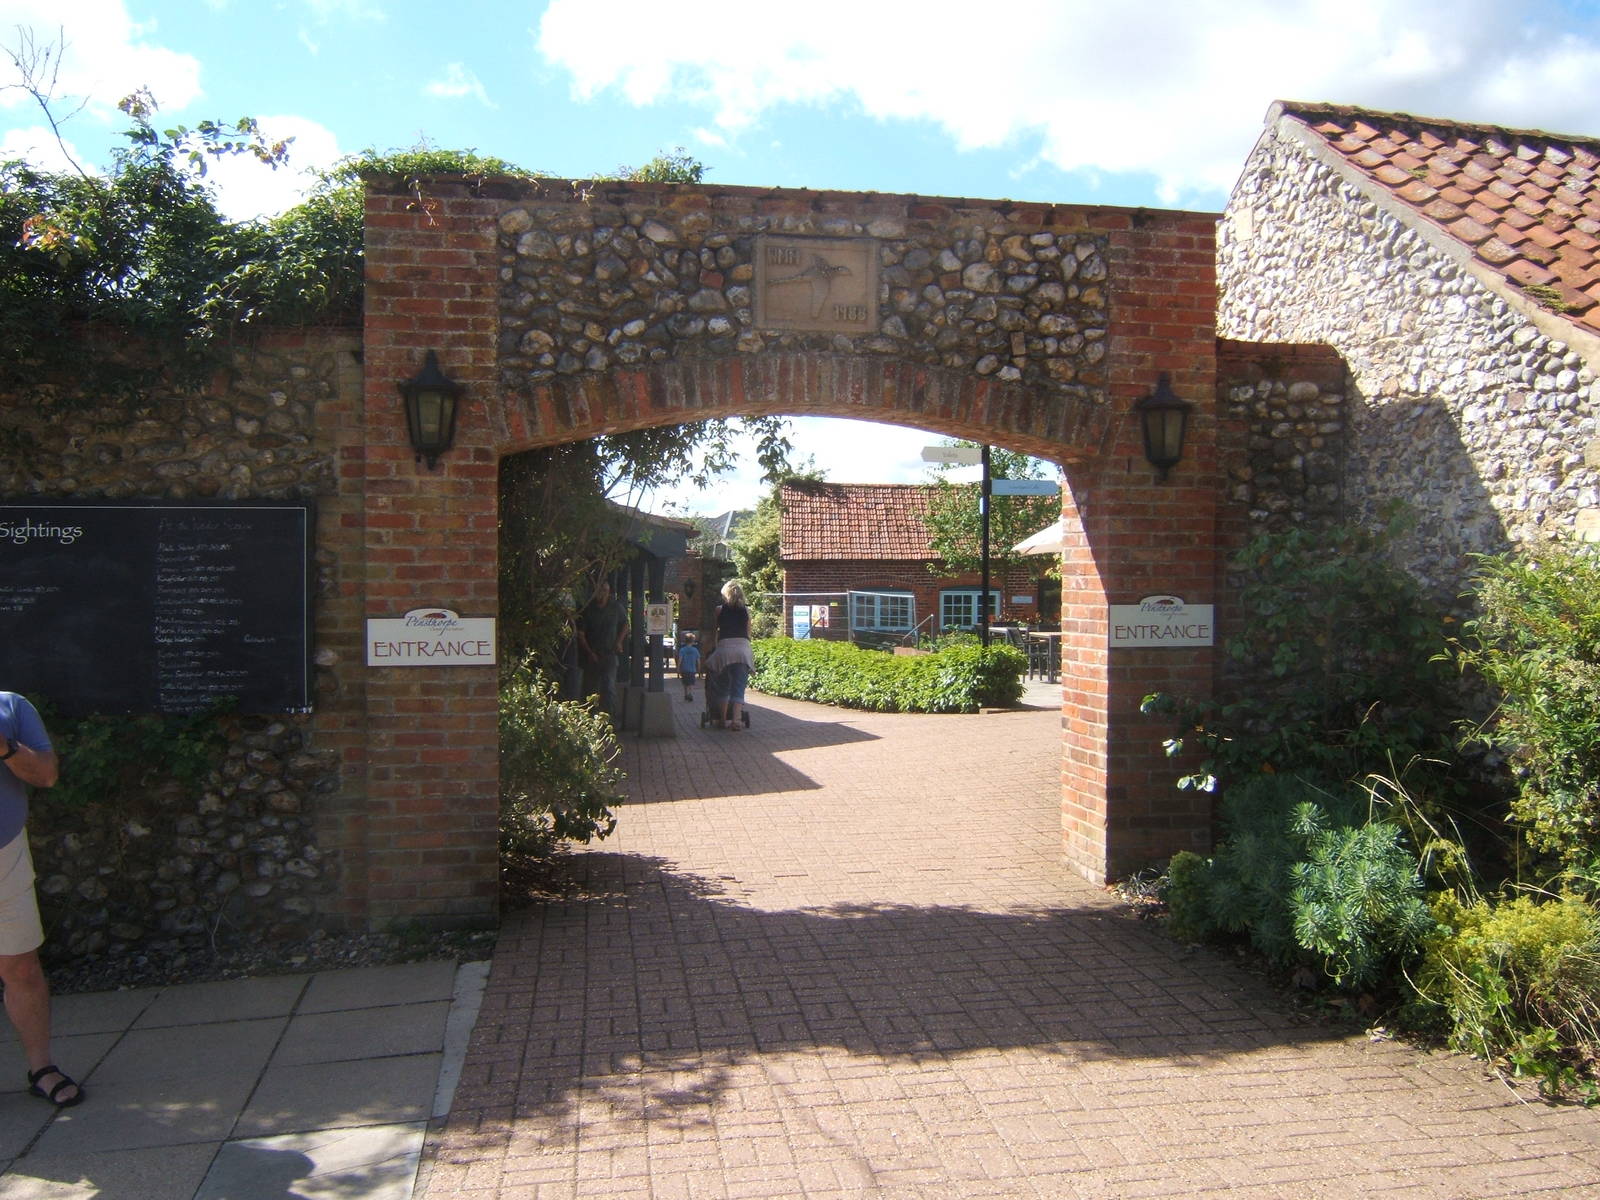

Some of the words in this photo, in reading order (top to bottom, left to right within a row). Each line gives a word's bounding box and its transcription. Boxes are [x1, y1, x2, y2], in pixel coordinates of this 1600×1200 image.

[0, 517, 84, 545] Sightings
[1115, 624, 1209, 640] ENTRANCE
[374, 640, 491, 657] ENTRANCE
